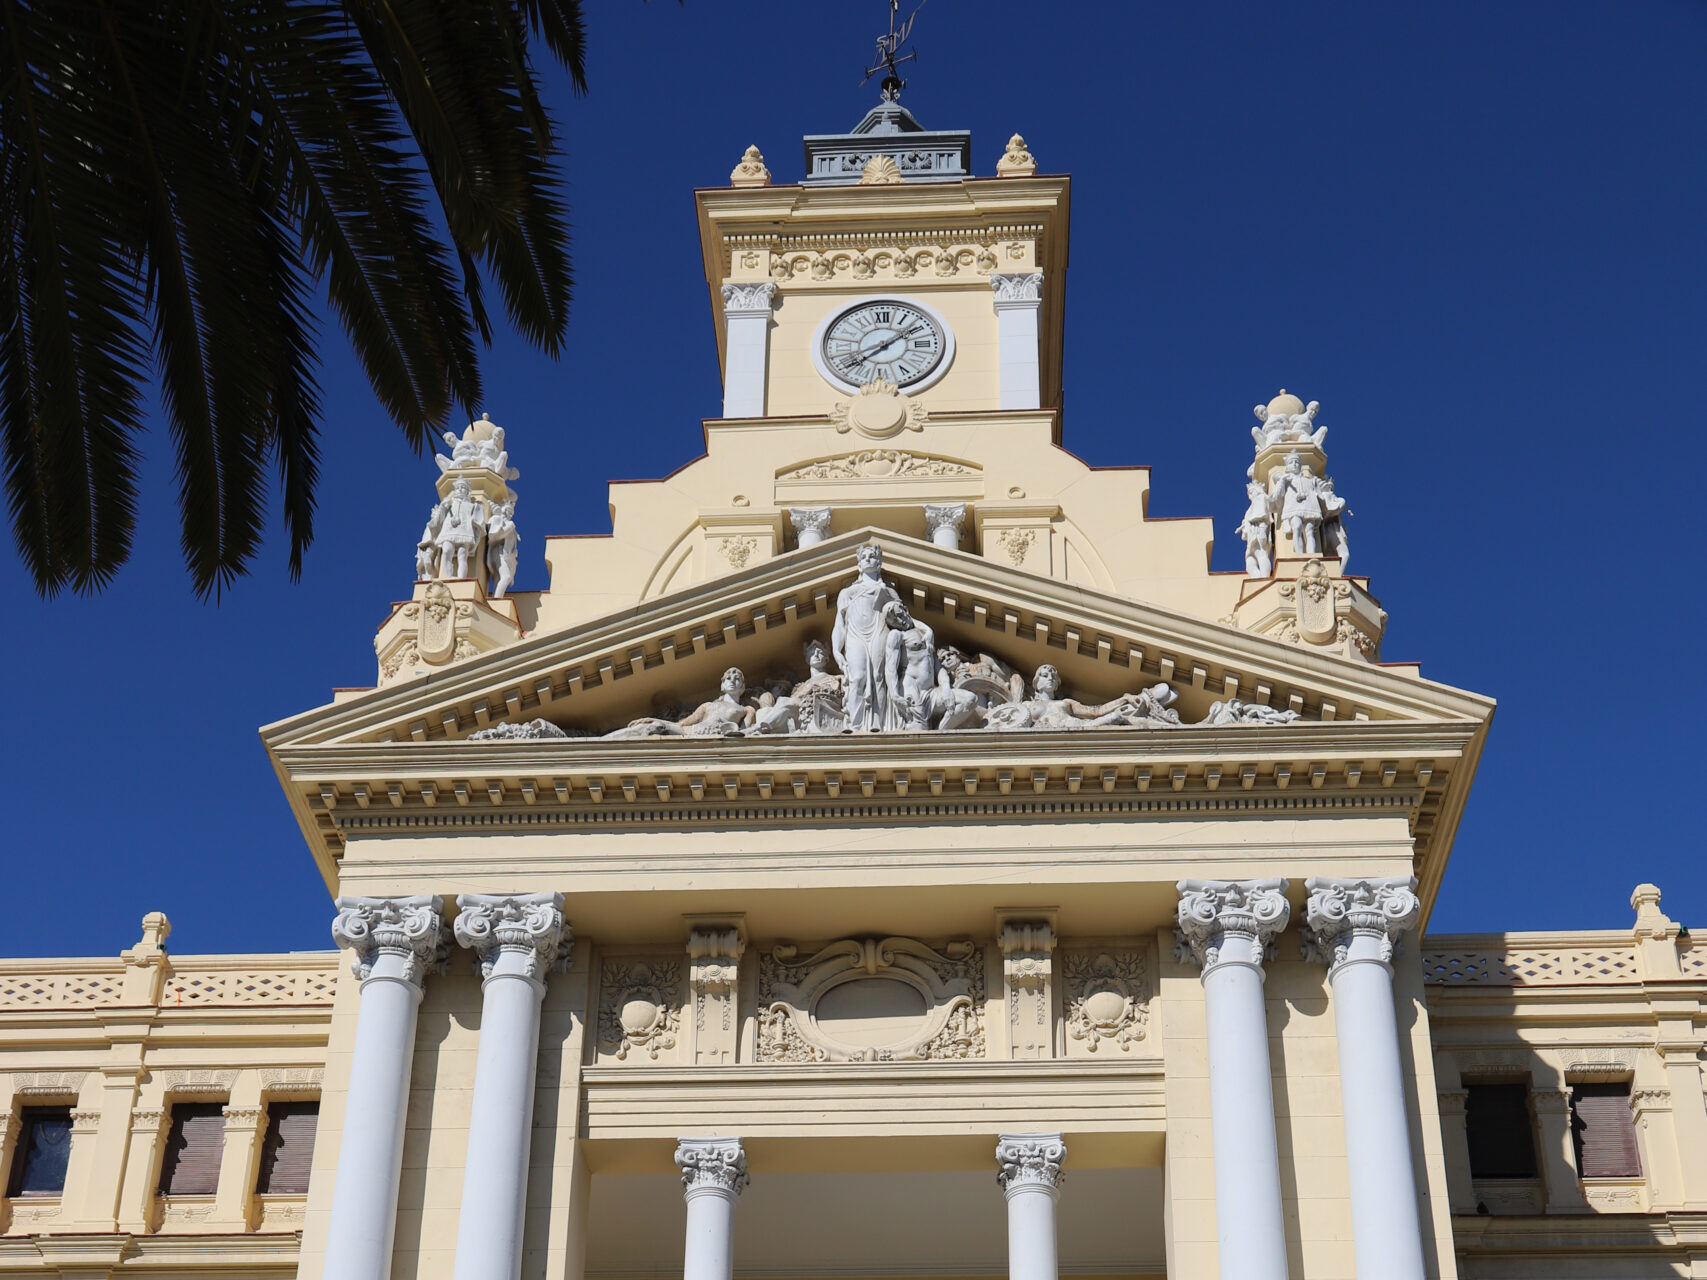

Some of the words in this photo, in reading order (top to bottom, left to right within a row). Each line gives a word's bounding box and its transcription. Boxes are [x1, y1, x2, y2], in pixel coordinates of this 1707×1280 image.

[875, 312, 890, 323] XII
[897, 313, 908, 326] I
[914, 340, 931, 348] III
